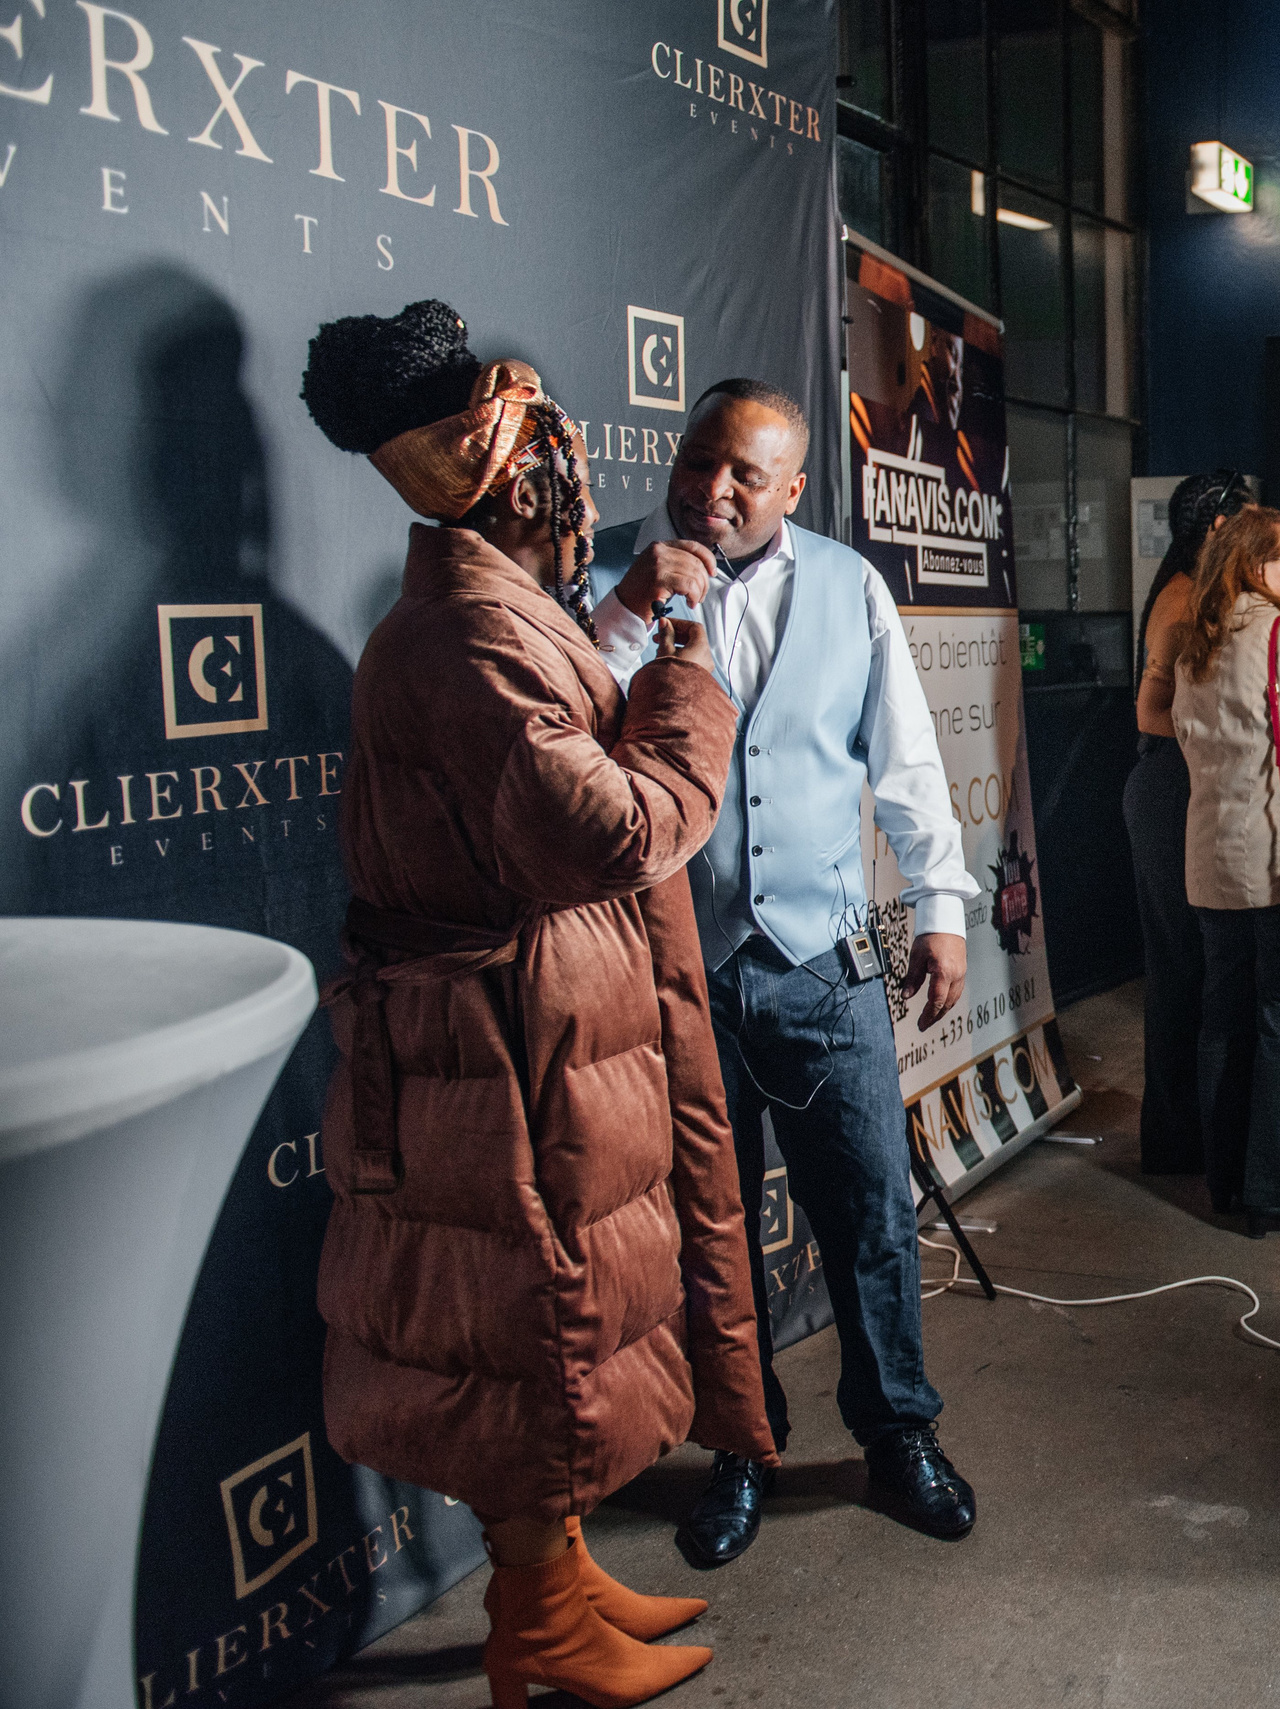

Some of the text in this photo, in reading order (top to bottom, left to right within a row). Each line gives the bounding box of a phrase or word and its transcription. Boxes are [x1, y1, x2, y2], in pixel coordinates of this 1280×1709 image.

[0, 0, 510, 227] ERXTER
[651, 41, 821, 142] CLIERXTER
[689, 103, 794, 155] EVENTS
[0, 143, 394, 271] ENTS
[572, 419, 685, 467] LIERX
[598, 473, 654, 493] EVE
[922, 549, 985, 574] Abonnez-vous
[907, 625, 933, 671] éo
[938, 628, 1007, 670] bientôt
[968, 702, 1001, 732] sur
[21, 751, 344, 838] CLIERXTE
[110, 813, 328, 867] EVENTS
[898, 1041, 929, 1075] arius
[939, 1015, 963, 1048] +33
[966, 1008, 974, 1035] 6
[976, 1000, 990, 1029] 86
[994, 992, 1006, 1020] 10
[1008, 986, 1021, 1011] 88
[1024, 976, 1036, 1002] 81
[911, 1041, 1058, 1163] NAVIS.COM
[139, 1505, 416, 1709] LIERXTER
